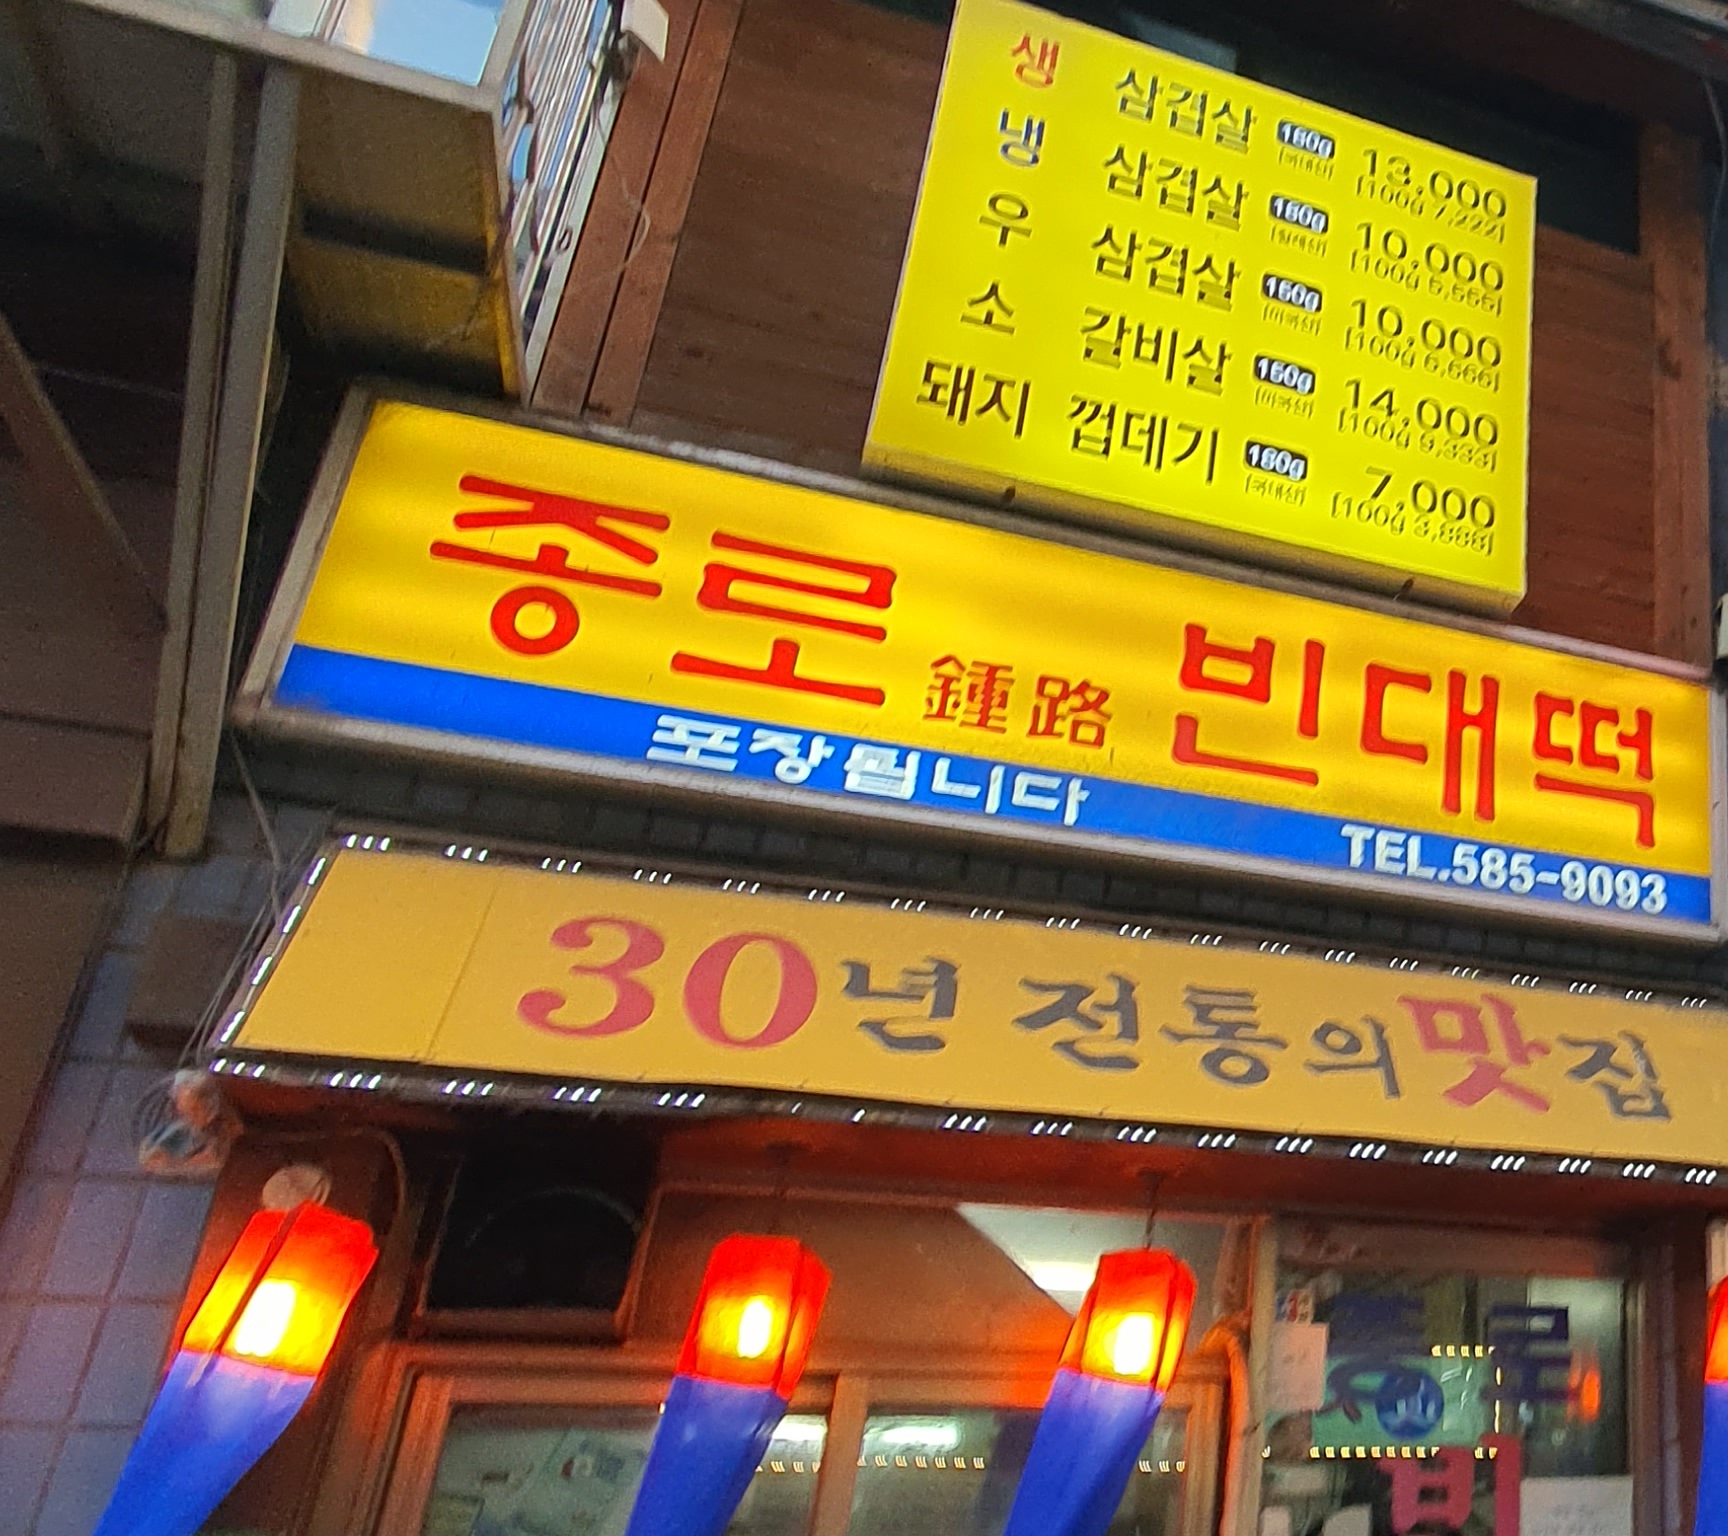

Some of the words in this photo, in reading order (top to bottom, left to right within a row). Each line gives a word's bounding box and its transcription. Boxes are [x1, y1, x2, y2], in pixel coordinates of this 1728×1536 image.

[997, 108, 1046, 170] 냉
[1100, 142, 1250, 232] 삼겹살
[1356, 220, 1506, 294] 10,000
[1010, 30, 1062, 90] 생
[1113, 66, 1260, 156] 삼겹살
[1362, 144, 1508, 222] 13,000
[959, 280, 1018, 338] 소
[1078, 304, 1234, 398] 갈비살
[1344, 374, 1500, 448] 14,000
[978, 190, 1034, 248] 우
[1090, 222, 1242, 314] 삼겹살
[1350, 294, 1504, 370] 10,000
[915, 358, 1034, 442] 돼지
[1065, 392, 1222, 486] 껍데기
[1364, 466, 1496, 530] 7,000
[428, 472, 898, 710] 종로
[1170, 622, 1658, 852] 빈대떡
[646, 712, 1092, 828] 포장됩니다
[1340, 822, 1668, 916] TEL.585-9093
[548, 916, 960, 1056] 30년
[1012, 970, 1404, 1100] 전통의
[1400, 994, 1672, 1124] 맛집
